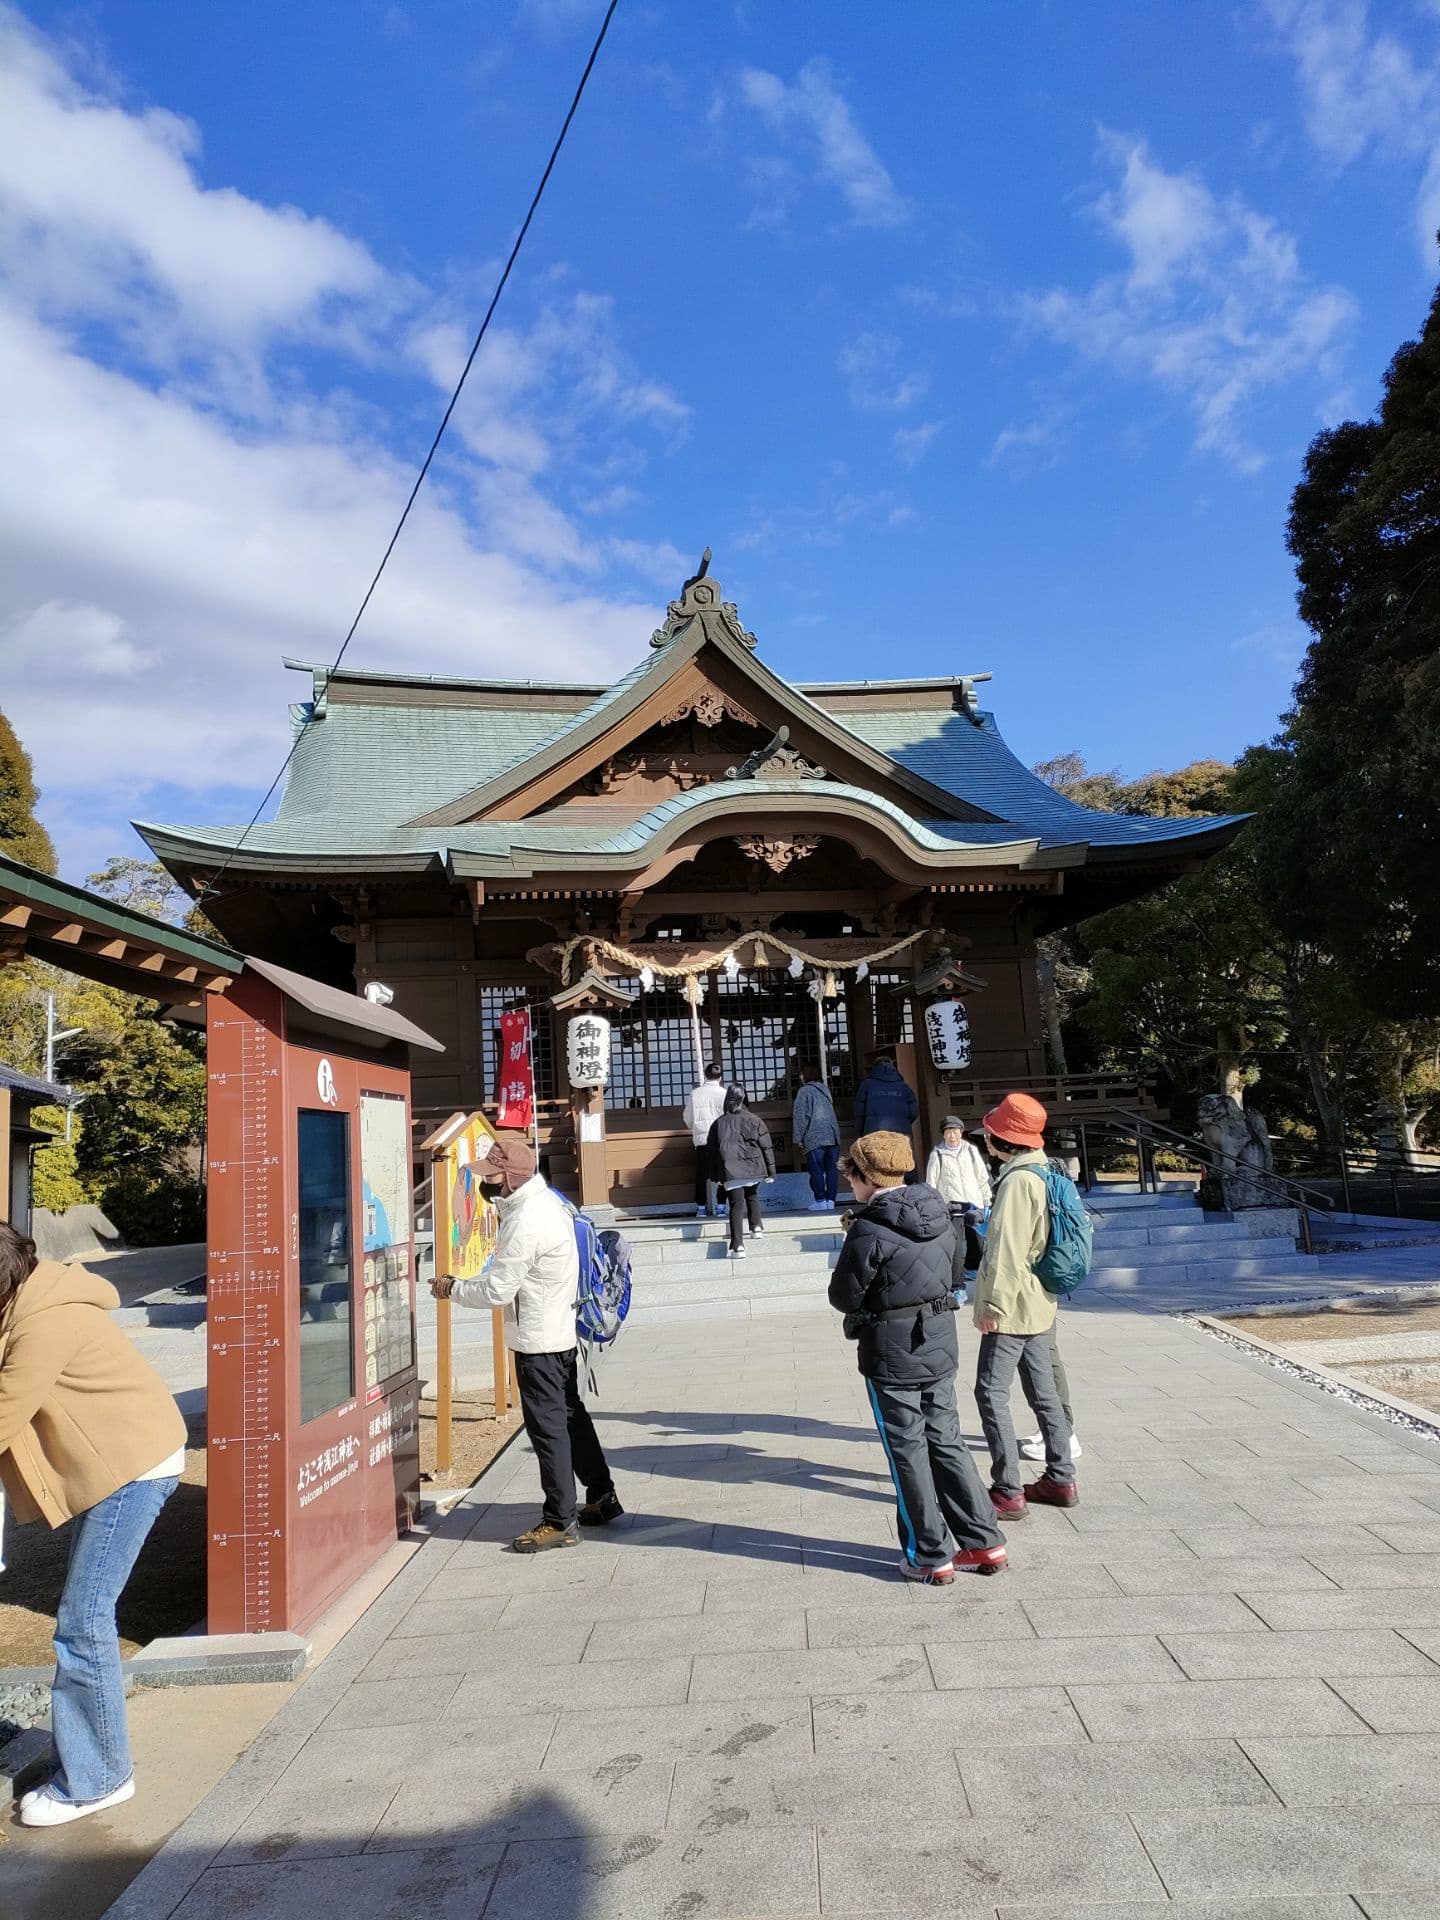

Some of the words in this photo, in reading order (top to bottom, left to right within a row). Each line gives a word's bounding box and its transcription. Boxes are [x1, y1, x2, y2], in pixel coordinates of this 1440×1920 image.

[576, 1020, 603, 1080] 御神燈
[927, 1011, 949, 1064] 浅江神社
[509, 1041, 526, 1101] 初詣
[264, 1338, 280, 1347] 三尺
[300, 1484, 323, 1508] Welcome
[264, 1529, 280, 1537] 一尺
